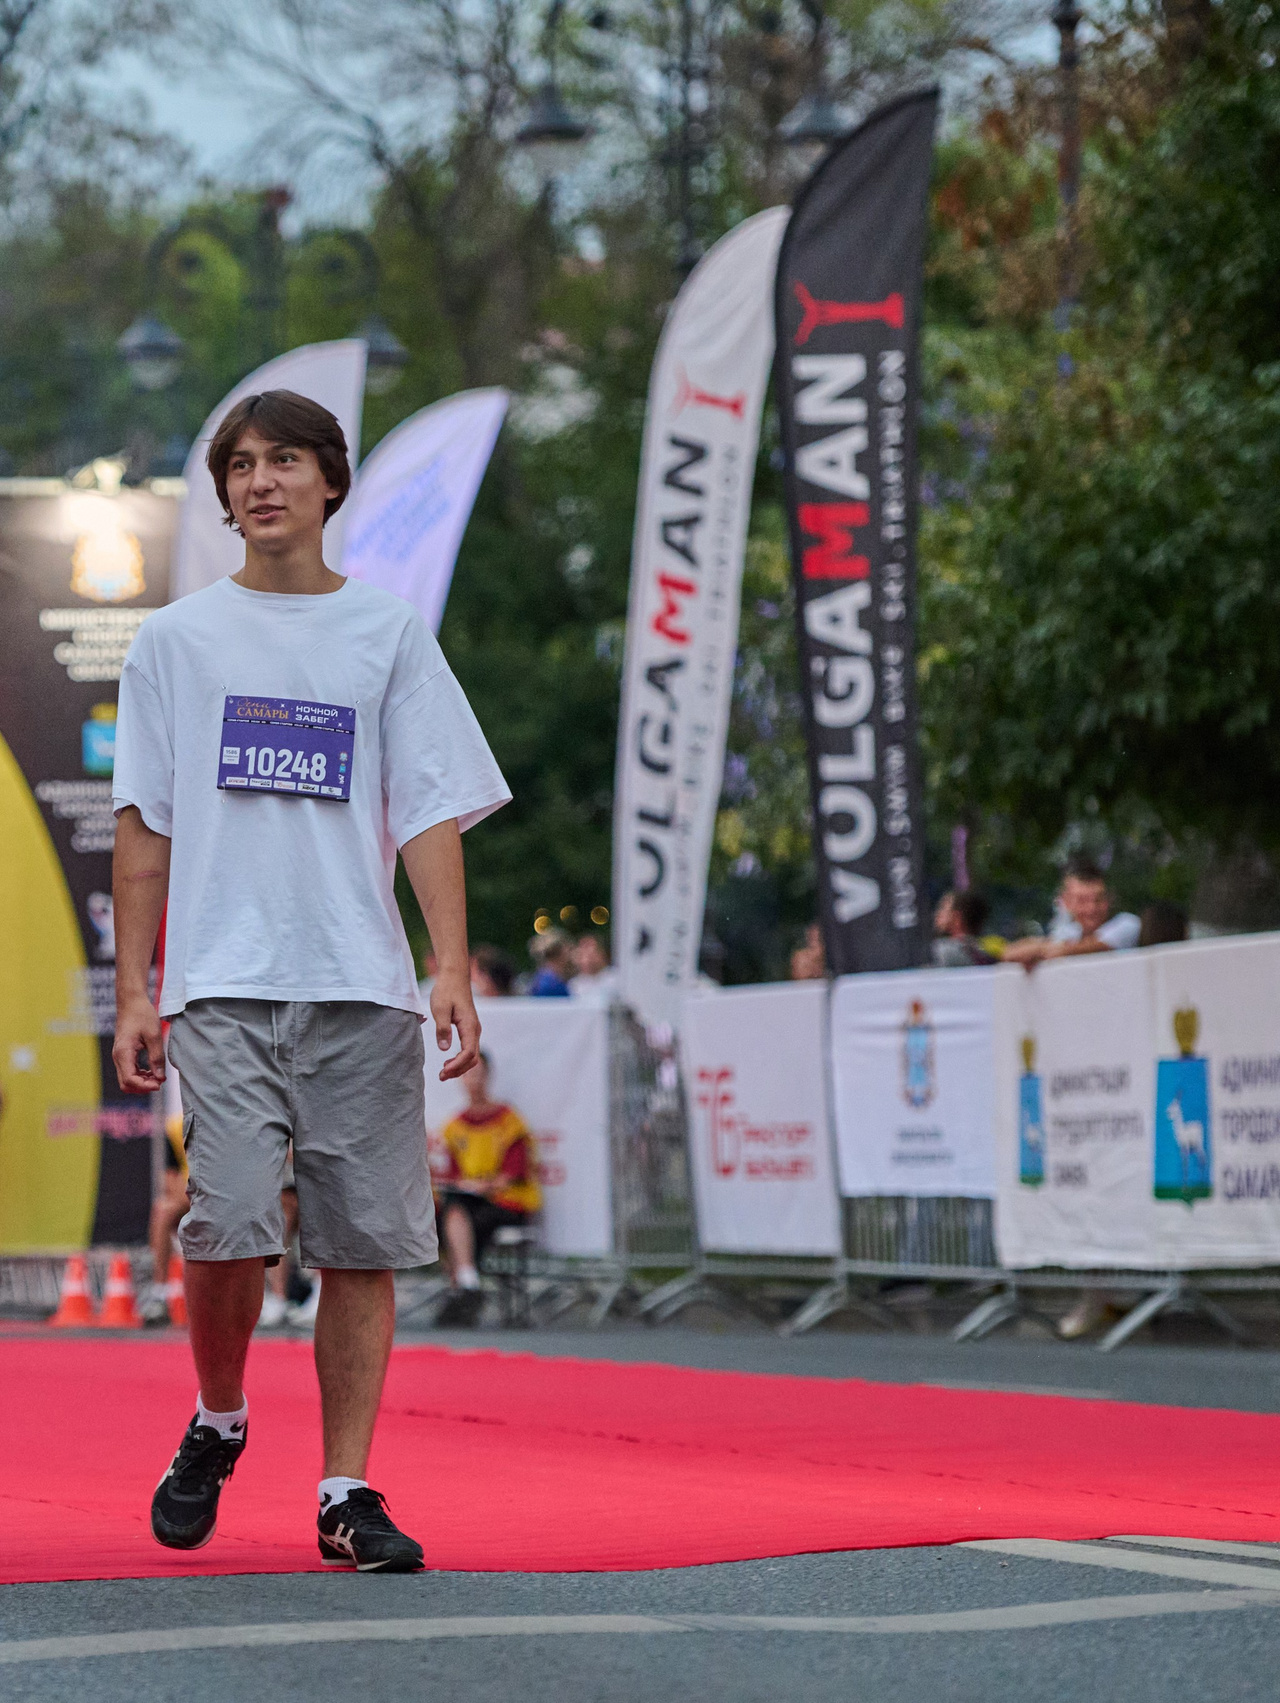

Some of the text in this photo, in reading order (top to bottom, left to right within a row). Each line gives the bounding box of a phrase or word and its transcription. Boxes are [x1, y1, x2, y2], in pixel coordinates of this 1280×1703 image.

[791, 353, 882, 924] VOLGAMAN
[236, 707, 289, 720] САМАРЫ
[295, 705, 339, 718] НОЧНОЙ
[295, 713, 330, 725] ЗАБЕГ
[245, 746, 328, 783] 10248
